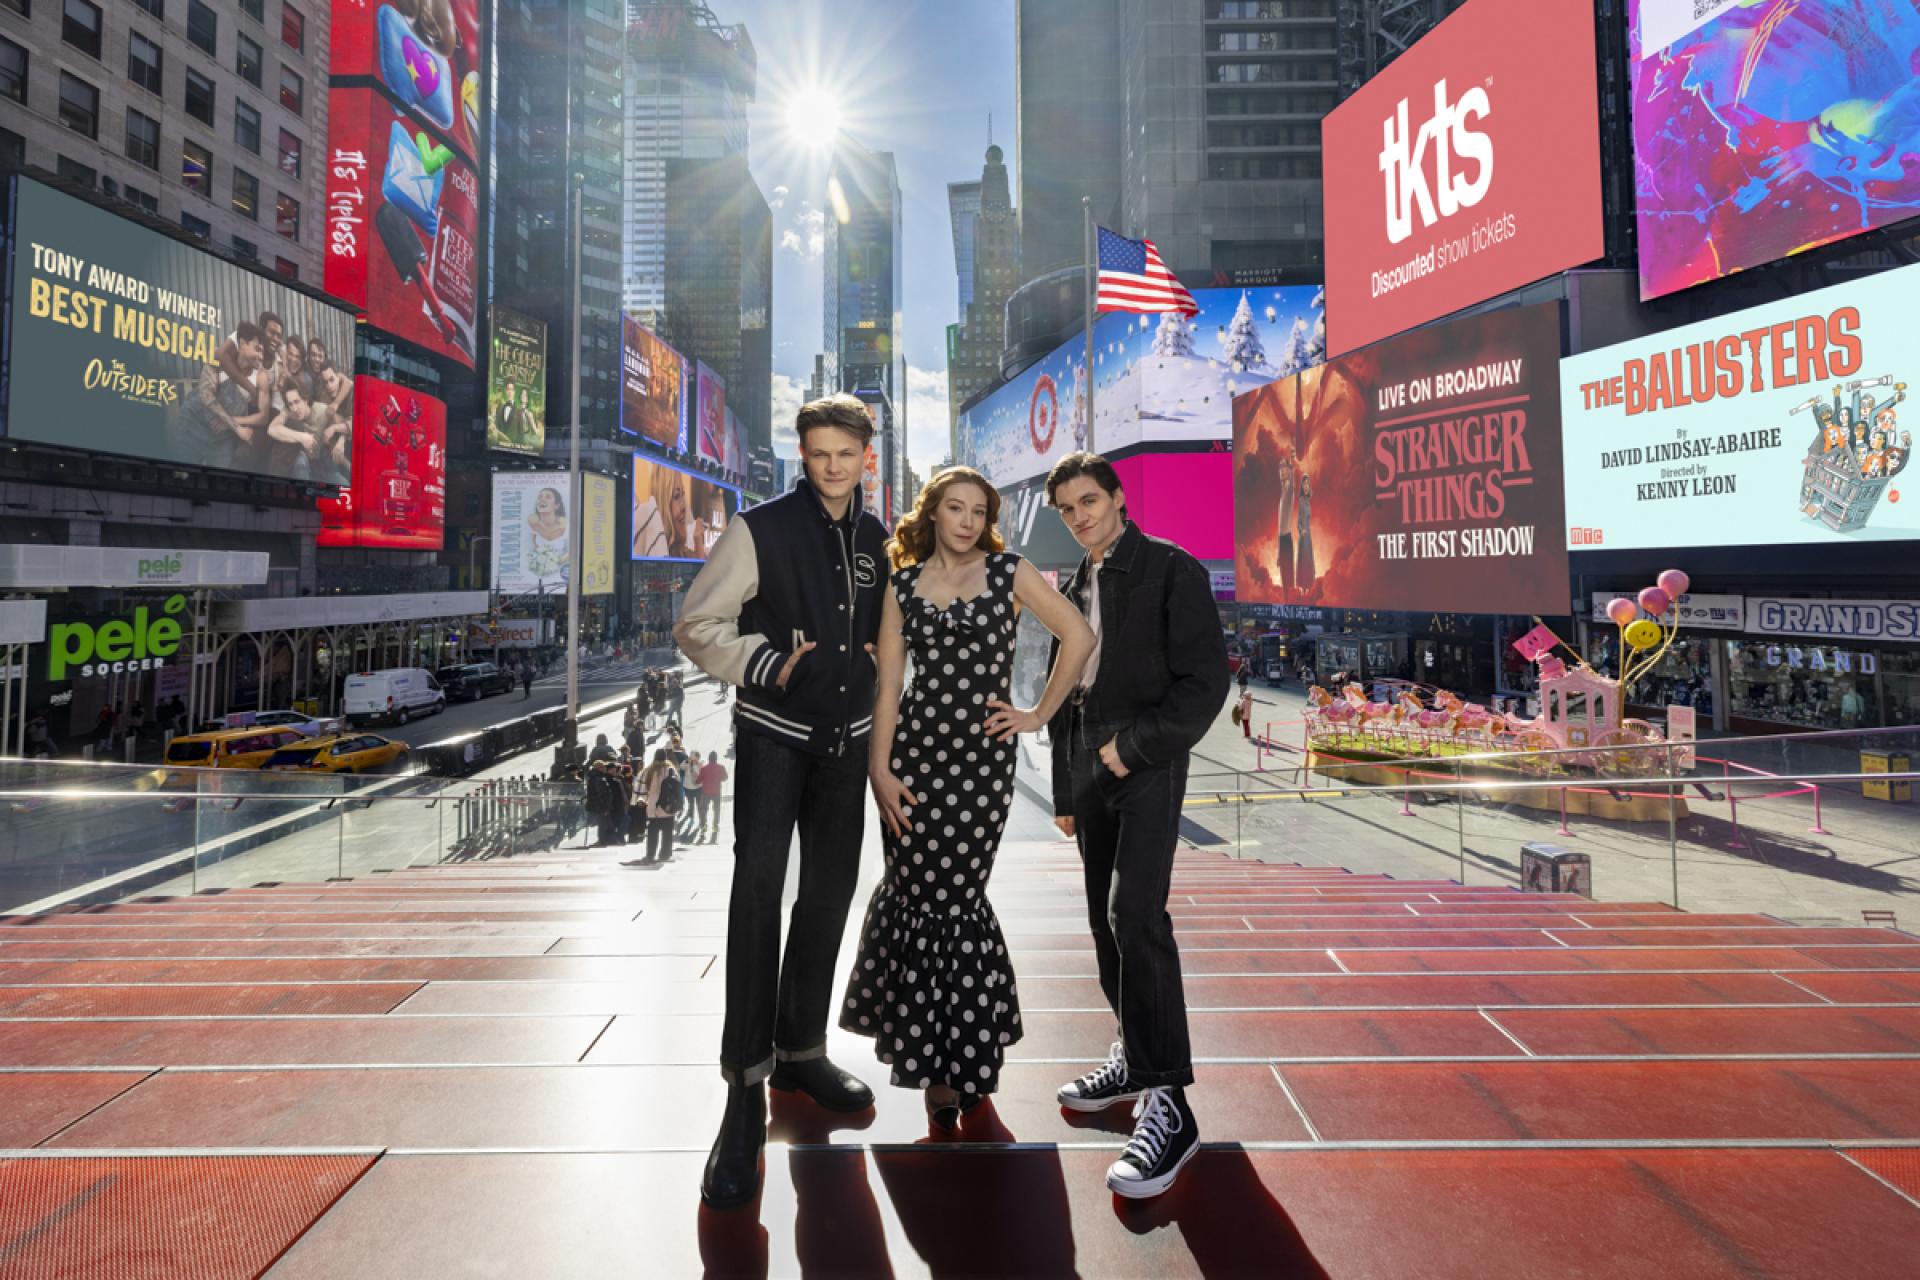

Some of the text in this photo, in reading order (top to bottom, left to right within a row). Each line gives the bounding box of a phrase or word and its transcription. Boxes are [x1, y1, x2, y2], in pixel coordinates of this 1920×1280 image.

[331, 149, 367, 181] It's
[1379, 77, 1493, 244] tkts
[1371, 211, 1516, 298] Discounted show tickets
[31, 243, 221, 328] TONY AWARD WINNER!
[30, 277, 220, 366] BEST MUSICAL
[1580, 306, 1863, 416] THE BALUSTERS
[1378, 358, 1522, 411] LIVE ON BROADWAY
[1375, 409, 1533, 488] STRANGER
[1601, 427, 1782, 469] DAVID LINDSAY-ABAIRE
[1676, 428, 1687, 440] By
[1637, 474, 1737, 501] KENNY LEON
[1660, 463, 1708, 479] Directed by
[1397, 469, 1505, 524] THINGS
[1377, 525, 1535, 560] THE FIRST SHADOW
[138, 552, 182, 578] pelé
[855, 553, 877, 587] S
[48, 593, 186, 681] pelé
[1760, 601, 1920, 638] GRAND S
[81, 657, 164, 678] SOCCER
[1767, 646, 1876, 674] GRAND
